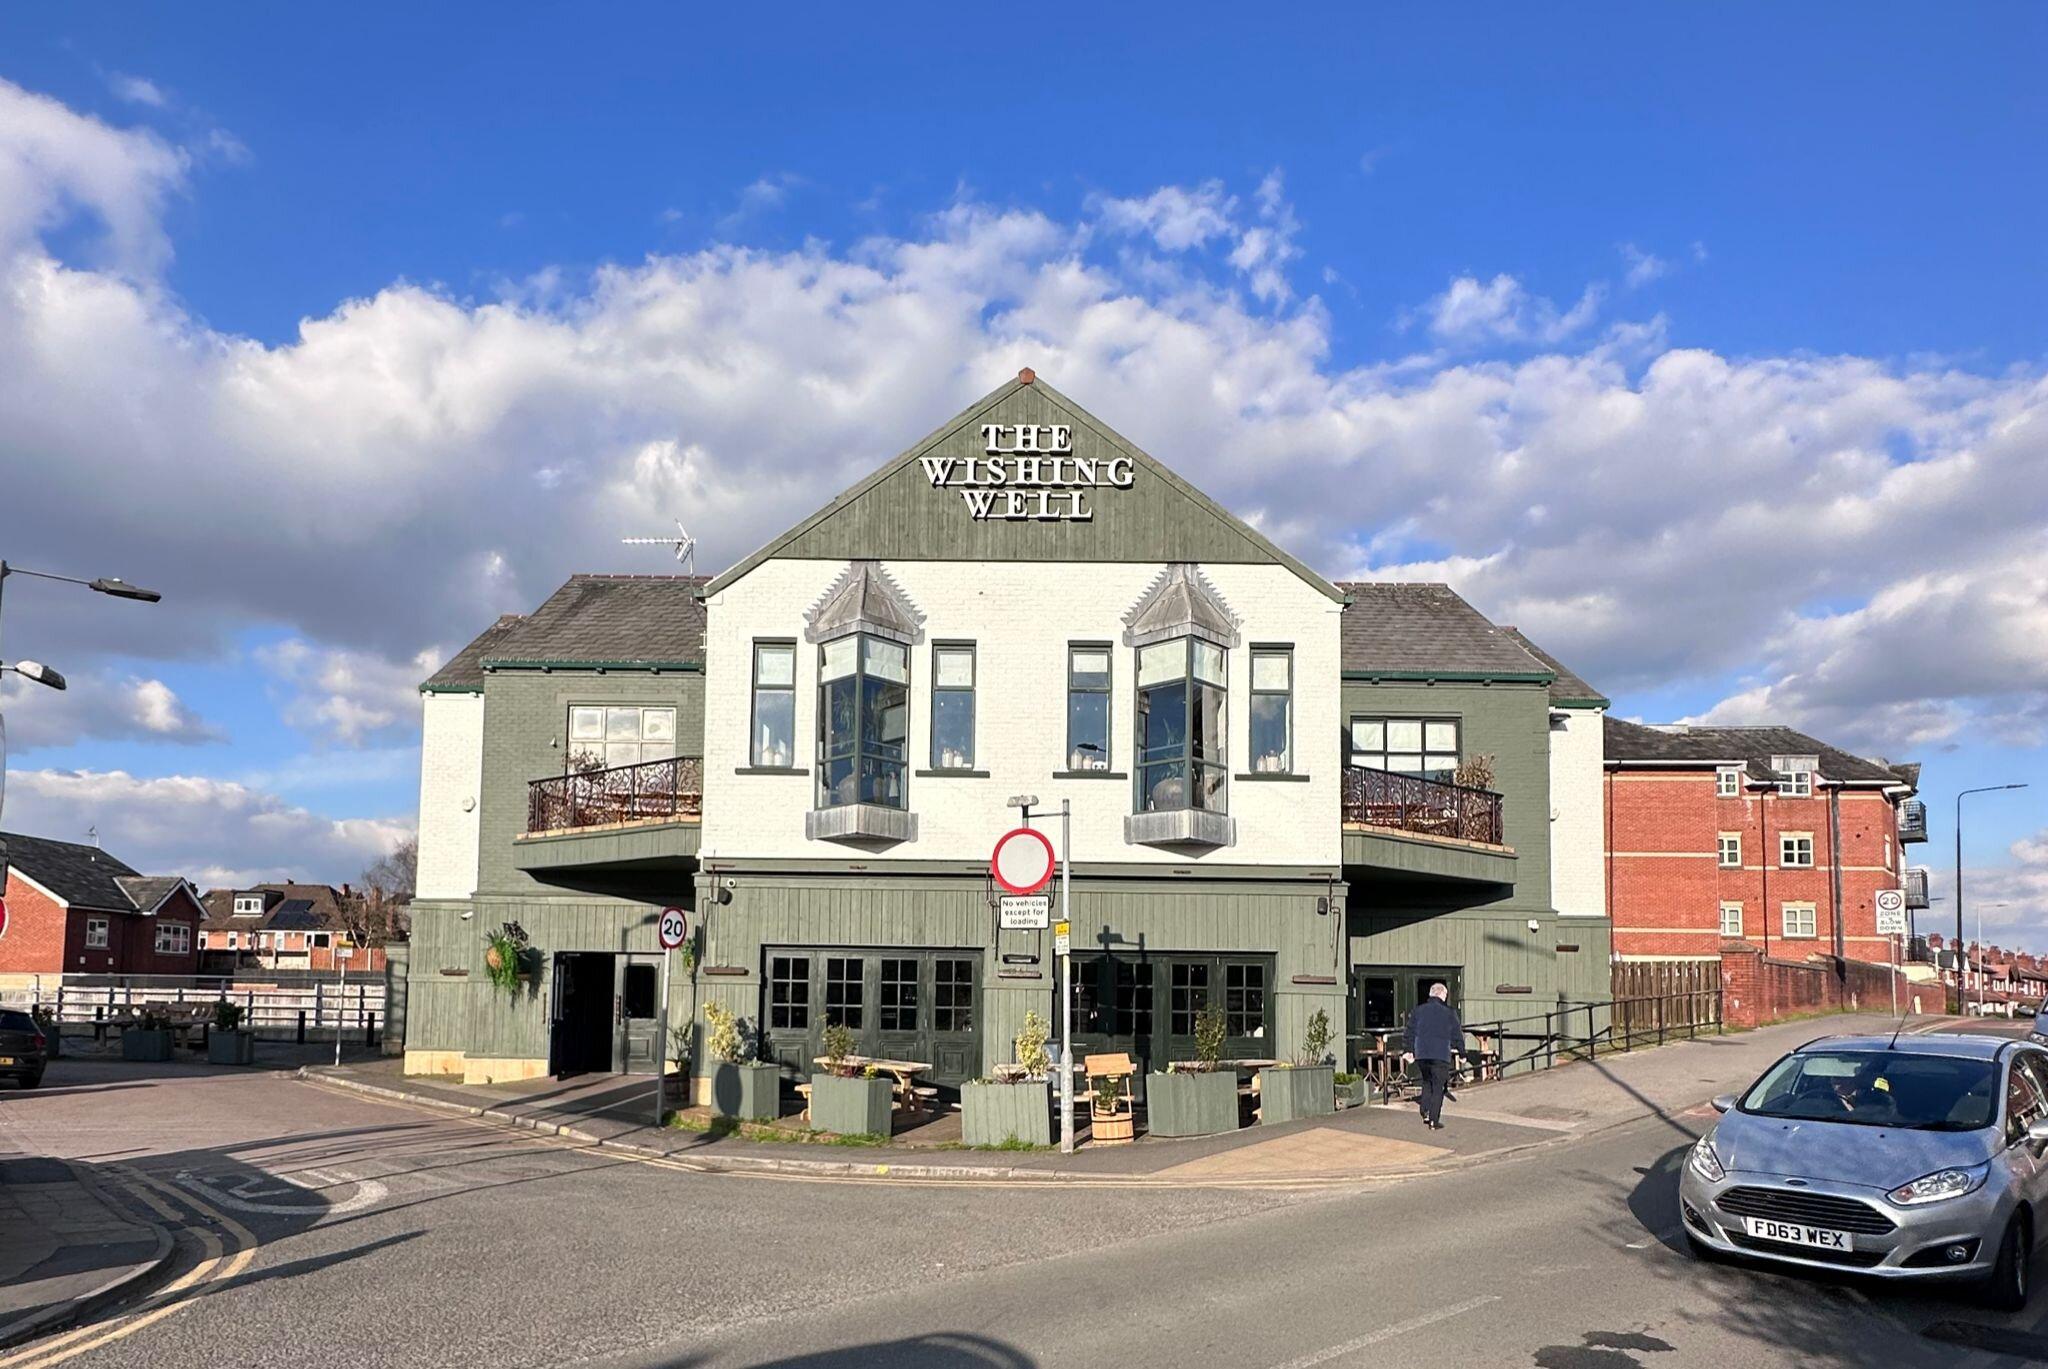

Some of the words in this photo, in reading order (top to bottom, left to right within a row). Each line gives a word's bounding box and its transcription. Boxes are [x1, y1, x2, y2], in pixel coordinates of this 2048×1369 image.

[981, 424, 1072, 452] THE
[919, 457, 1135, 486] WISHING
[960, 490, 1092, 519] WELL
[1882, 897, 1899, 905] 20
[664, 918, 683, 937] 20
[1755, 1221, 1801, 1241] FD63
[1807, 1228, 1844, 1248] WEX
